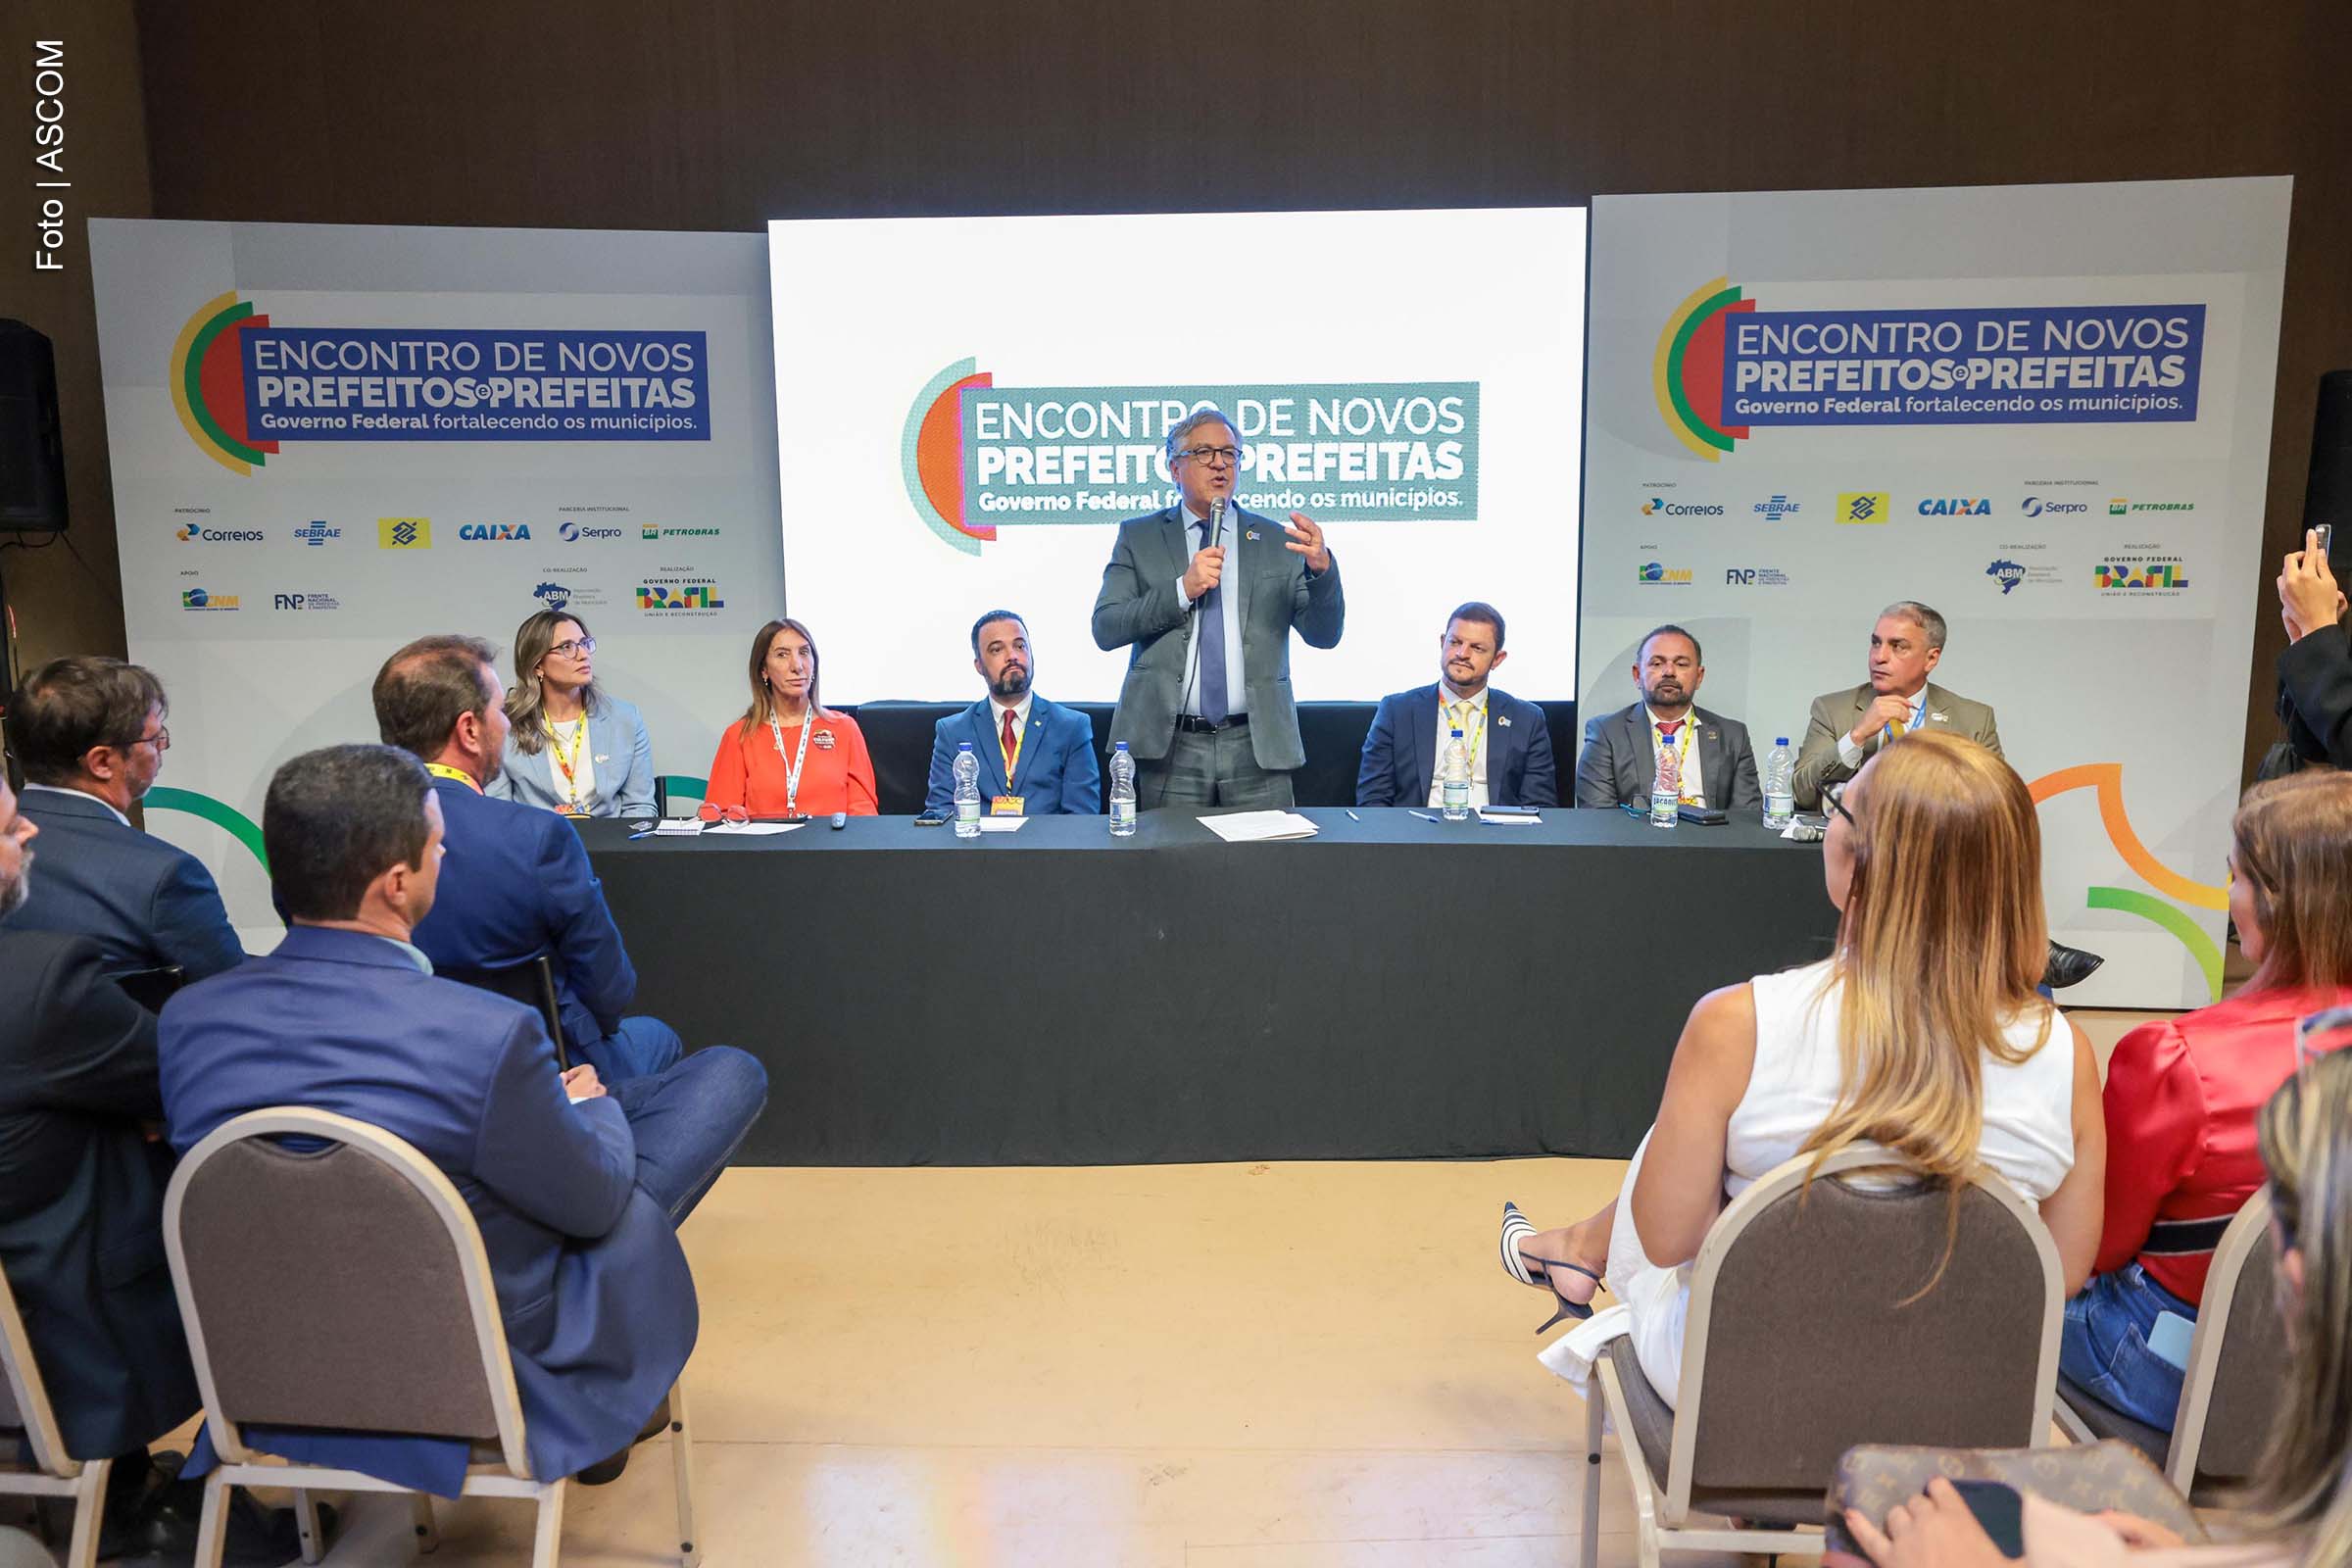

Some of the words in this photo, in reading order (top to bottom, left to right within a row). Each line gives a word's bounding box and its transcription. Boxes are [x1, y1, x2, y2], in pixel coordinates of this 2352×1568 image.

[1738, 321, 1962, 355] ENCONTRO
[1977, 320, 2030, 352] DE
[2044, 318, 2188, 351] NOVOS
[254, 340, 480, 371] ENCONTRO
[495, 342, 545, 371] DE
[560, 342, 695, 372] NOVOS
[1736, 359, 1955, 392] PREFEITOS
[1967, 355, 2185, 390] PREFEITAS
[257, 375, 477, 409] PREFEITOS
[489, 377, 696, 409] PREFEITAS
[1735, 398, 1819, 415] Governo
[1824, 397, 1901, 414] Federal
[1905, 395, 2034, 413] fortalecendo
[2040, 399, 2063, 412] os
[2068, 393, 2183, 415] municípios.
[261, 414, 347, 429] Governo
[352, 413, 428, 429] Federal
[433, 413, 559, 429] fortalecendo
[564, 416, 585, 429] os
[591, 414, 698, 433] municípios.
[976, 400, 1220, 439] ENCONTR
[1237, 398, 1296, 437] DE
[1309, 396, 1465, 436] NOVOS
[979, 492, 1071, 512] Governo
[1076, 490, 1161, 510] Federal
[1310, 492, 1336, 508] os
[1665, 503, 1724, 515] Correios
[1753, 503, 1800, 513] SEBRAE
[1918, 499, 1992, 515] CAIXA
[2045, 502, 2087, 514] Serpro
[202, 529, 264, 541] Correios
[294, 528, 341, 538] SEBRAE
[459, 524, 531, 540] CAIXA
[582, 526, 621, 539] Serpro
[1726, 568, 1755, 585] FNP
[1997, 567, 2024, 579] ABM
[2093, 565, 2189, 588] BRASIL
[274, 594, 304, 610] FNP
[544, 591, 568, 601] ABM
[636, 586, 724, 609] BRASIL
